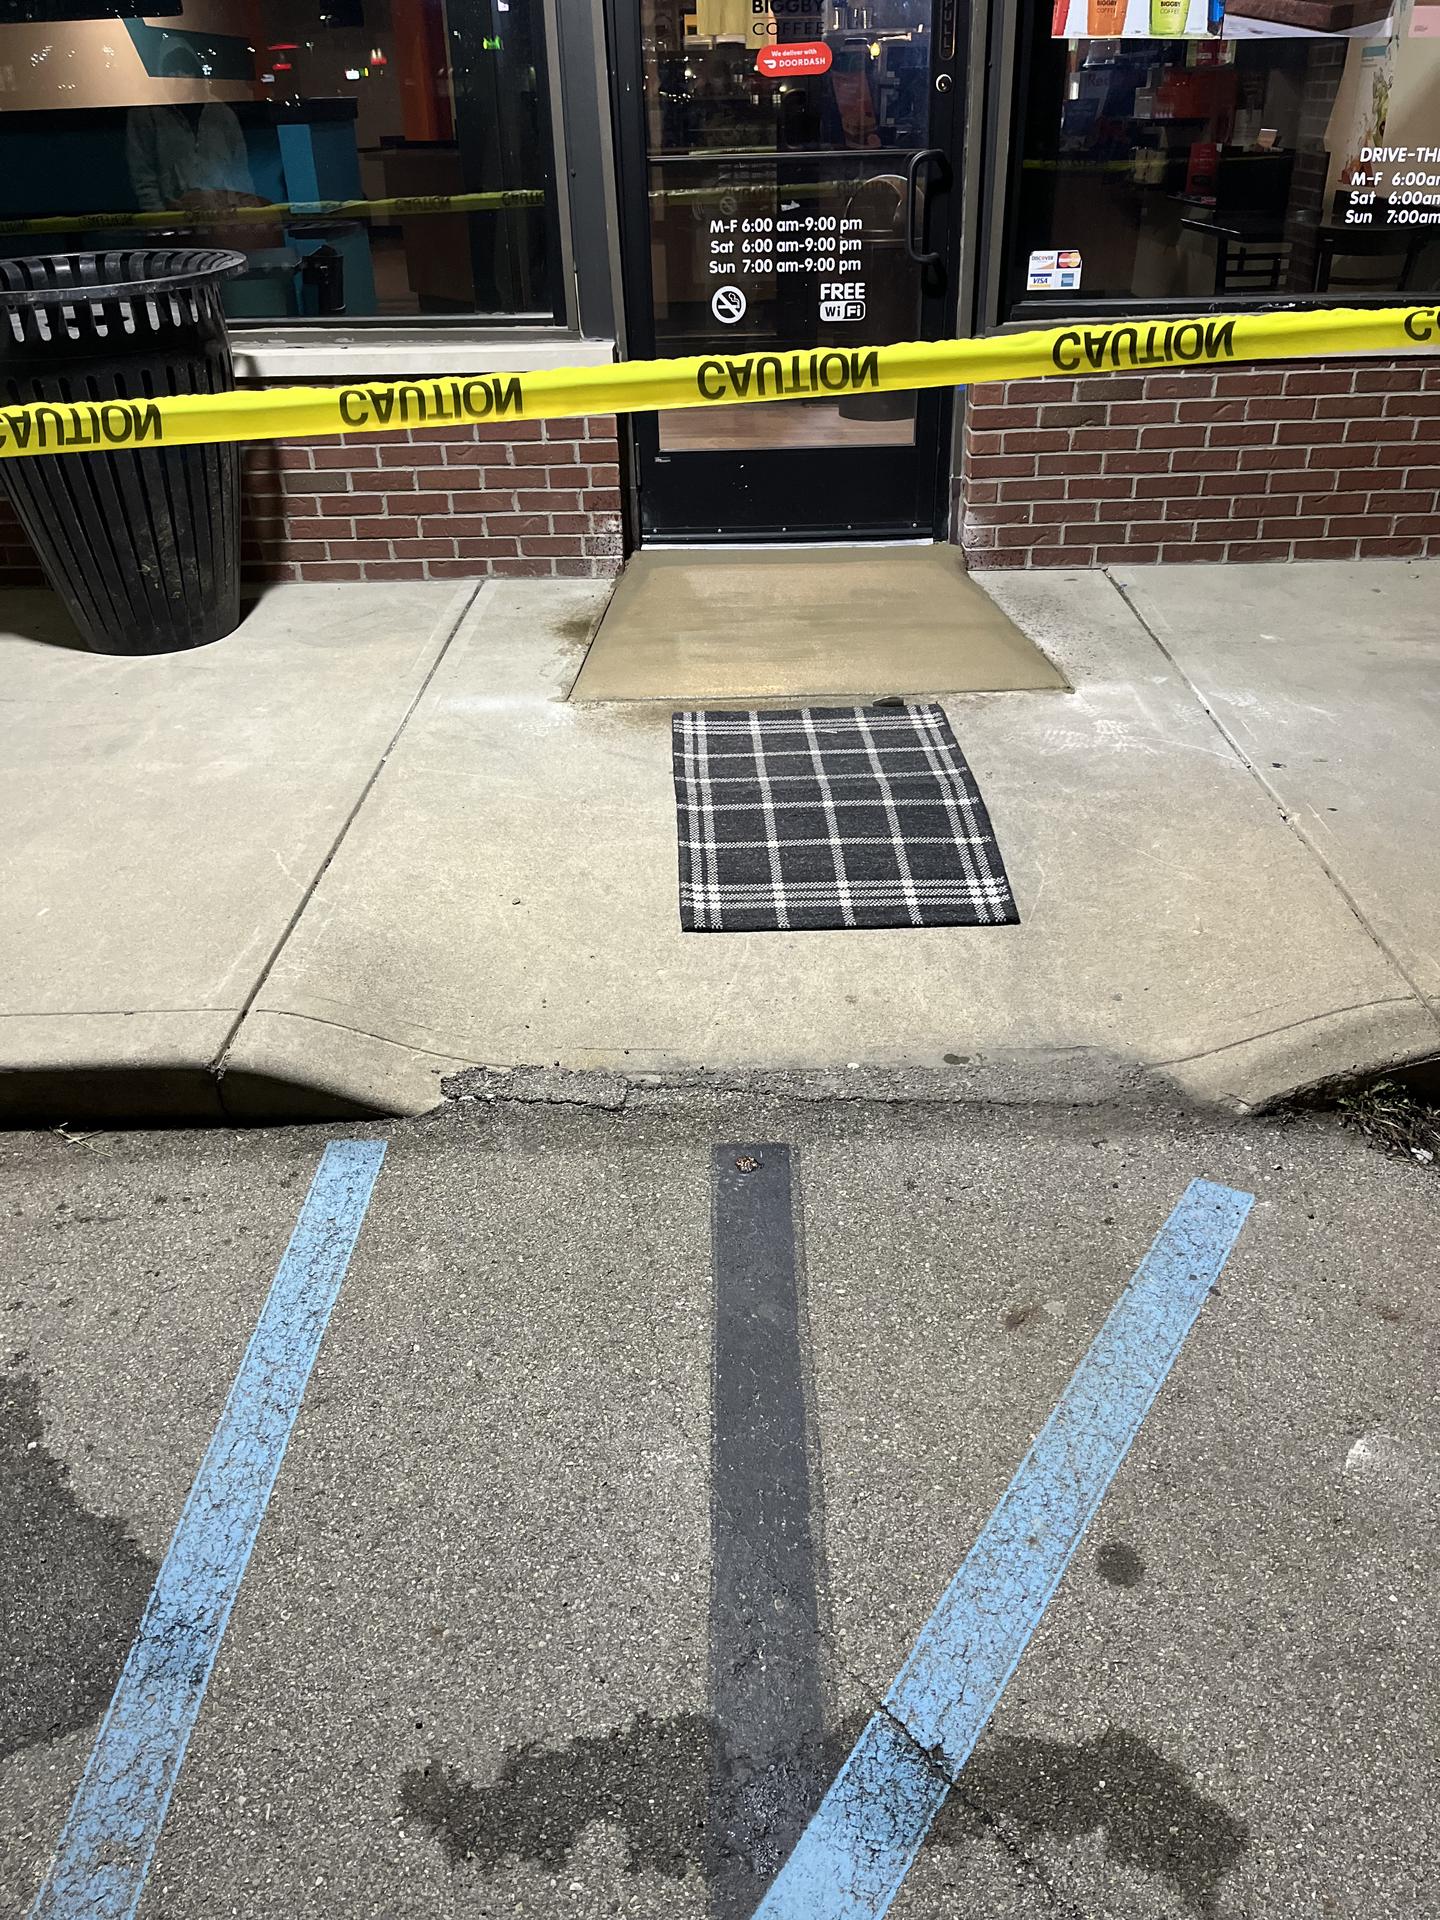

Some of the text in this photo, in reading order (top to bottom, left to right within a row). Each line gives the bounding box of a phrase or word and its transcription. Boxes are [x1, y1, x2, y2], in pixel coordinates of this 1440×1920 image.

[752, 0, 824, 14] BIGGBY
[752, 22, 824, 35] COFFEE
[782, 49, 803, 57] deliver
[779, 57, 826, 67] DOORDASH
[1360, 147, 1440, 163] DRIVE-TH
[1351, 172, 1384, 186] M-F
[1349, 190, 1376, 205] Sat
[1344, 209, 1440, 224] Sun 7:00am
[710, 220, 738, 233] M-F
[741, 218, 773, 233] 6:00
[839, 218, 863, 234] pm
[711, 241, 734, 254] Sat
[741, 239, 773, 253] 6:00
[839, 239, 862, 254] pm
[709, 260, 736, 274] Sun
[742, 259, 773, 273] 7:00
[838, 259, 861, 274] pm
[820, 282, 866, 300] FREE
